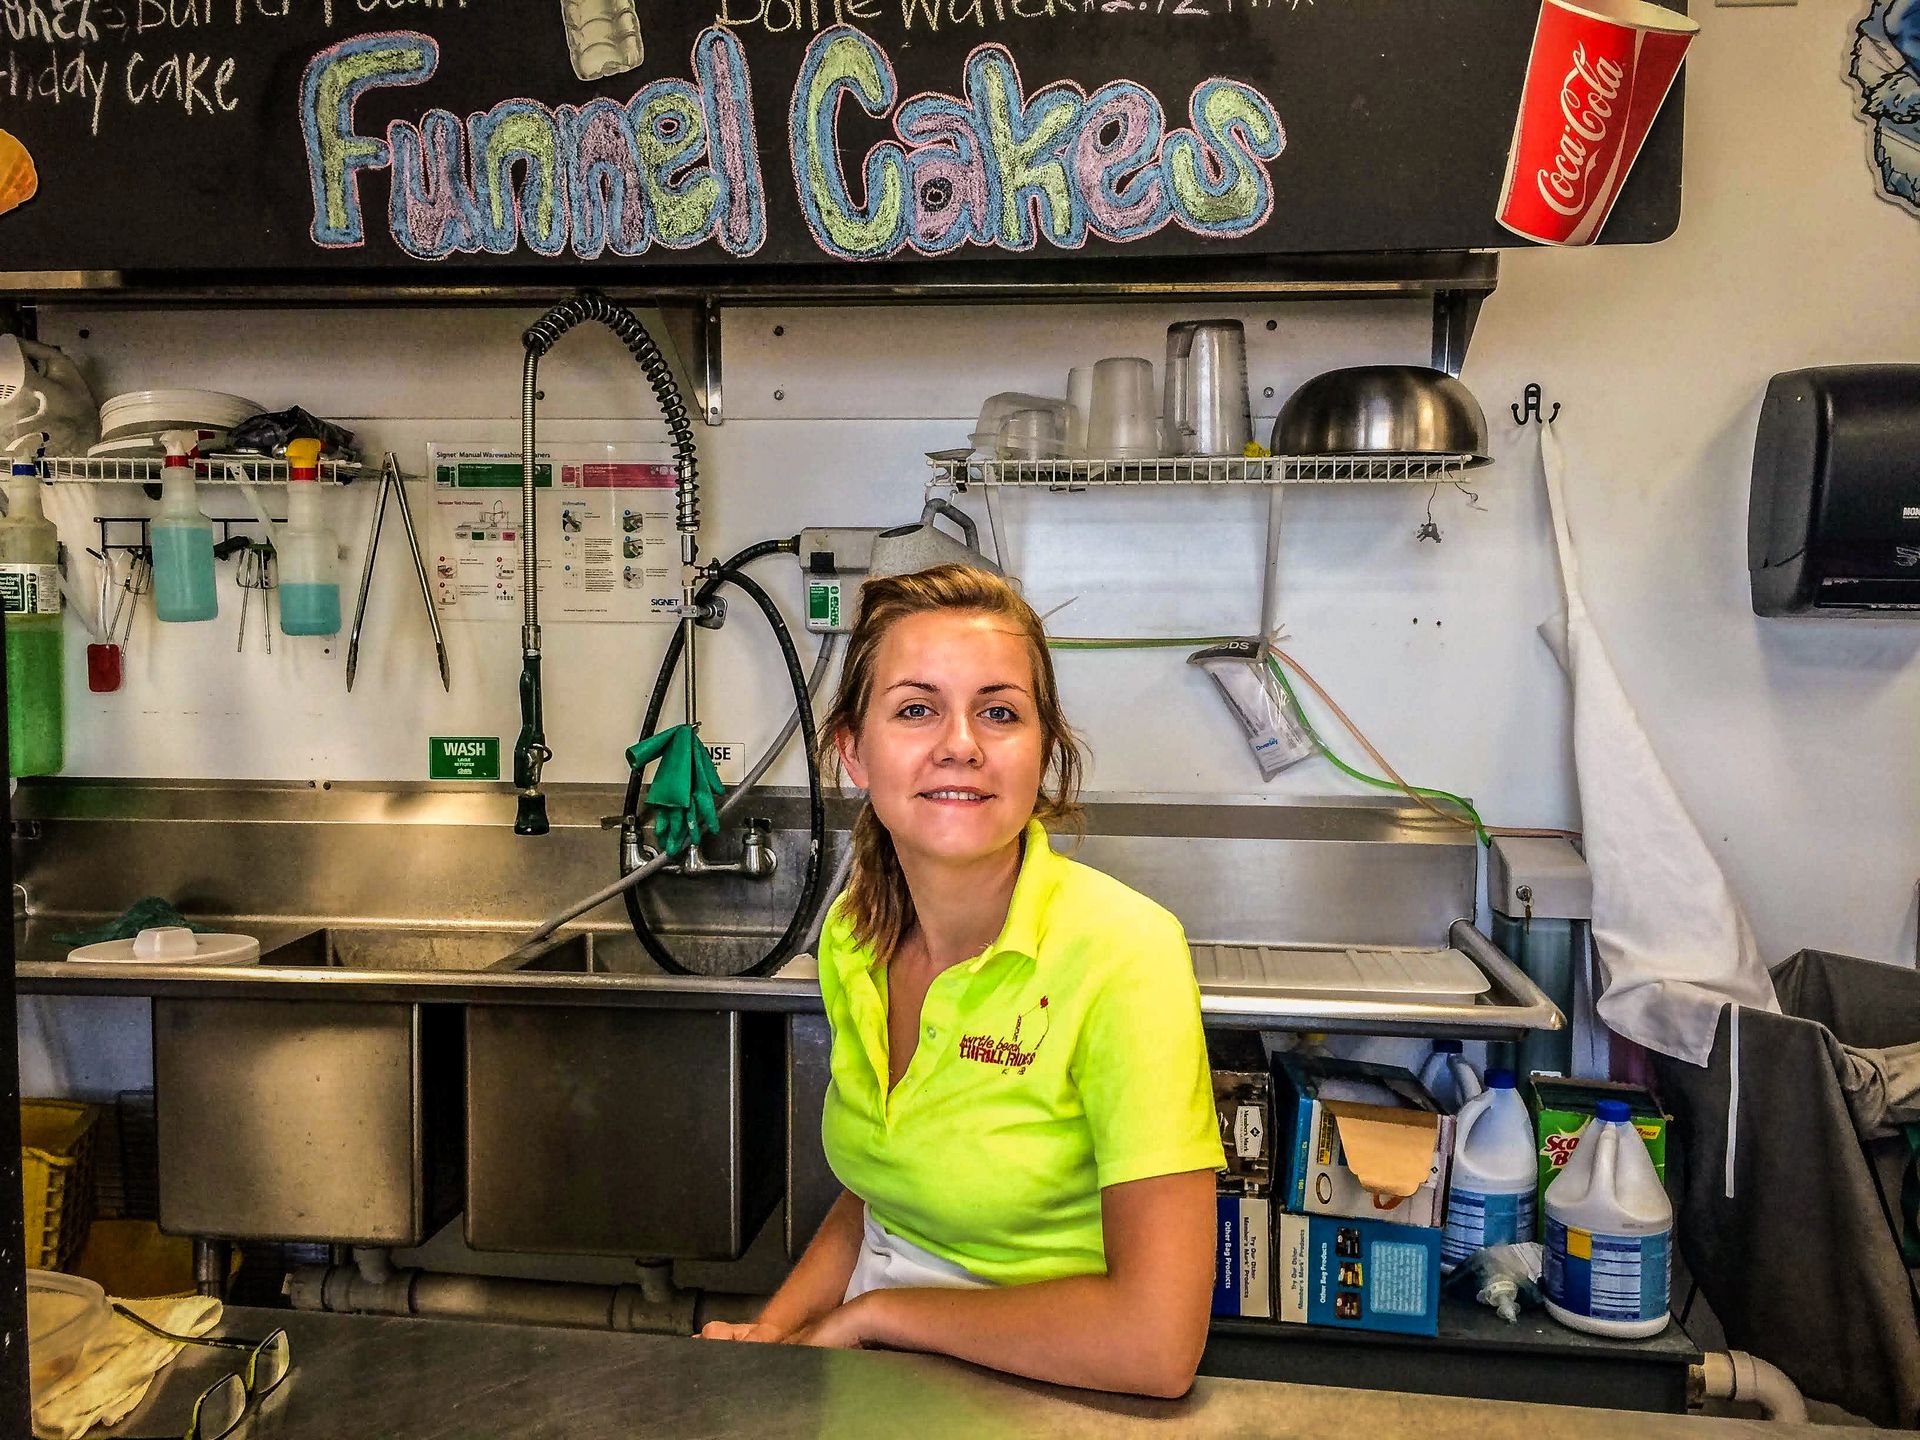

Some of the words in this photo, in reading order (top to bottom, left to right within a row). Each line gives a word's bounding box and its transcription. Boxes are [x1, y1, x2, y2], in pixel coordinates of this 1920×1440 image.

[301, 25, 767, 261] Funnel
[789, 25, 1287, 261] Cakes
[443, 742, 486, 756] WASH
[705, 746, 731, 760] NSE
[1224, 1221, 1232, 1241] Other
[1223, 1242, 1232, 1256] Bag
[1224, 1257, 1232, 1289] Products
